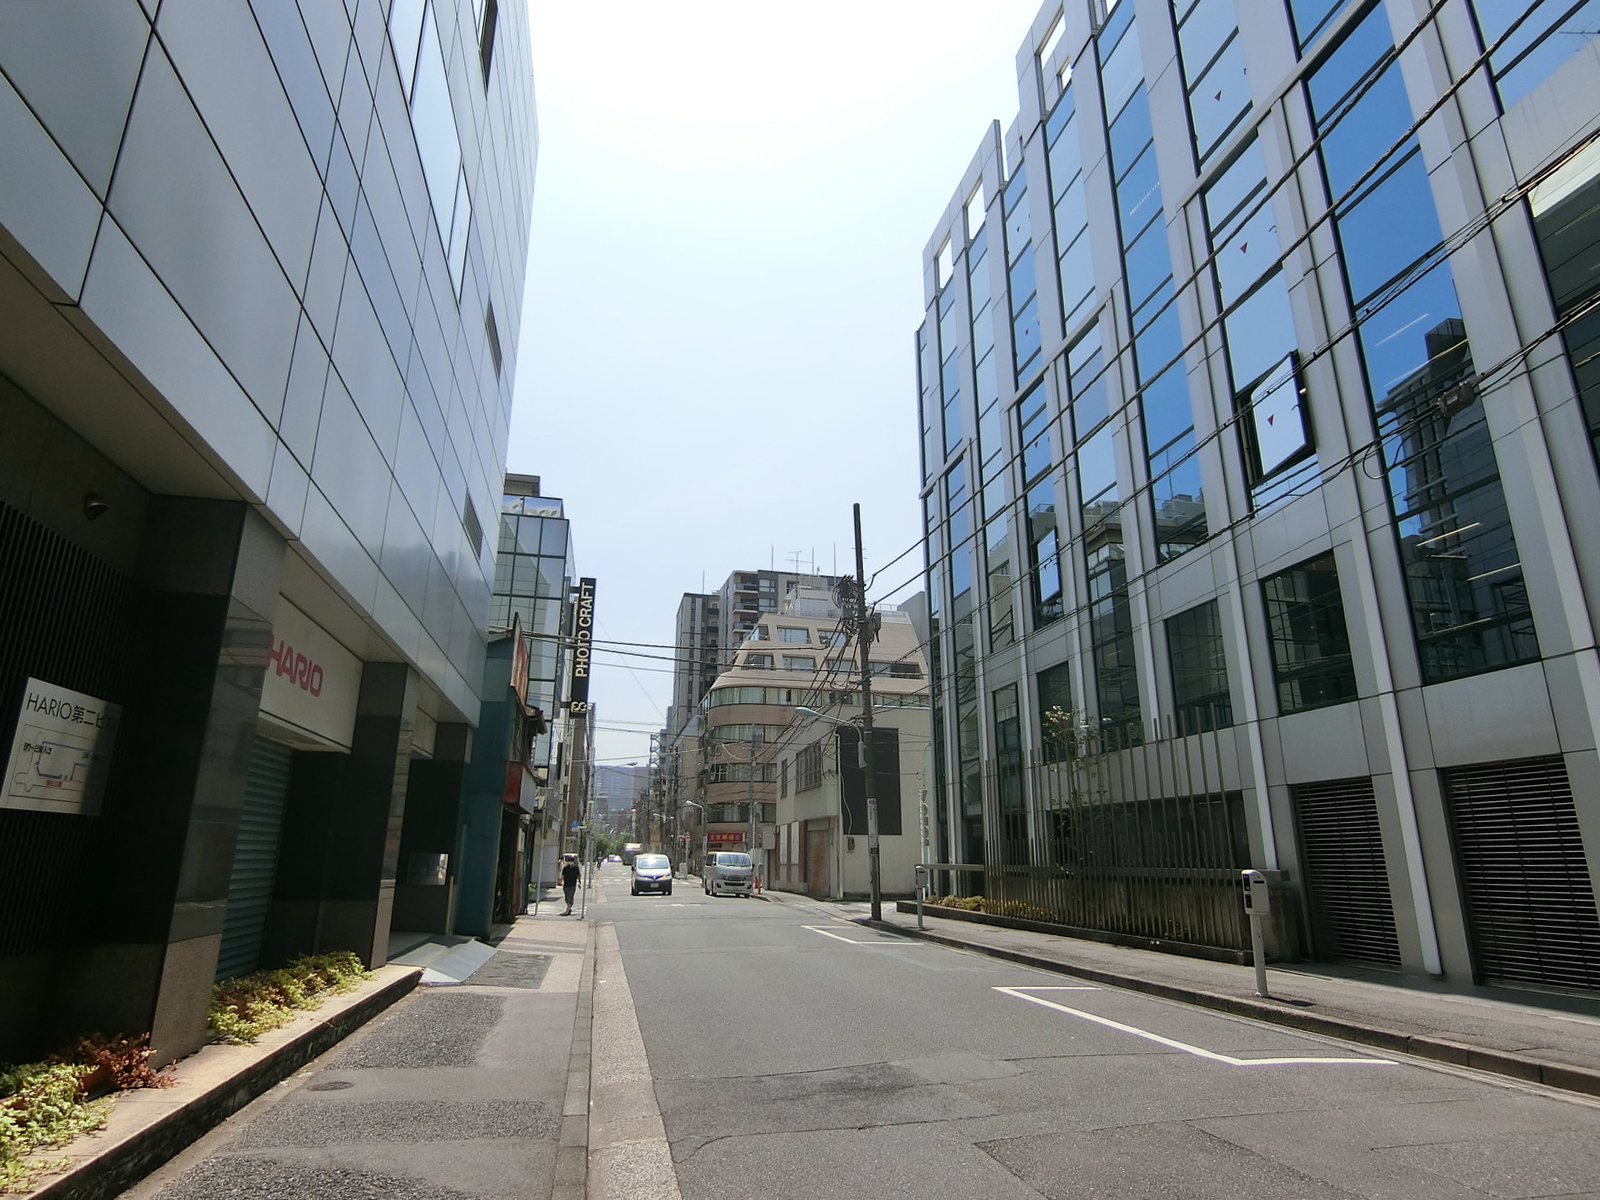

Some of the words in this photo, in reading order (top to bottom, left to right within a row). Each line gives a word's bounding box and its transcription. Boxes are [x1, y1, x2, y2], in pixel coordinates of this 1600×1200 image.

[579, 582, 594, 627] CRAFT
[265, 634, 324, 697] HARIO
[575, 630, 590, 677] PHOTO
